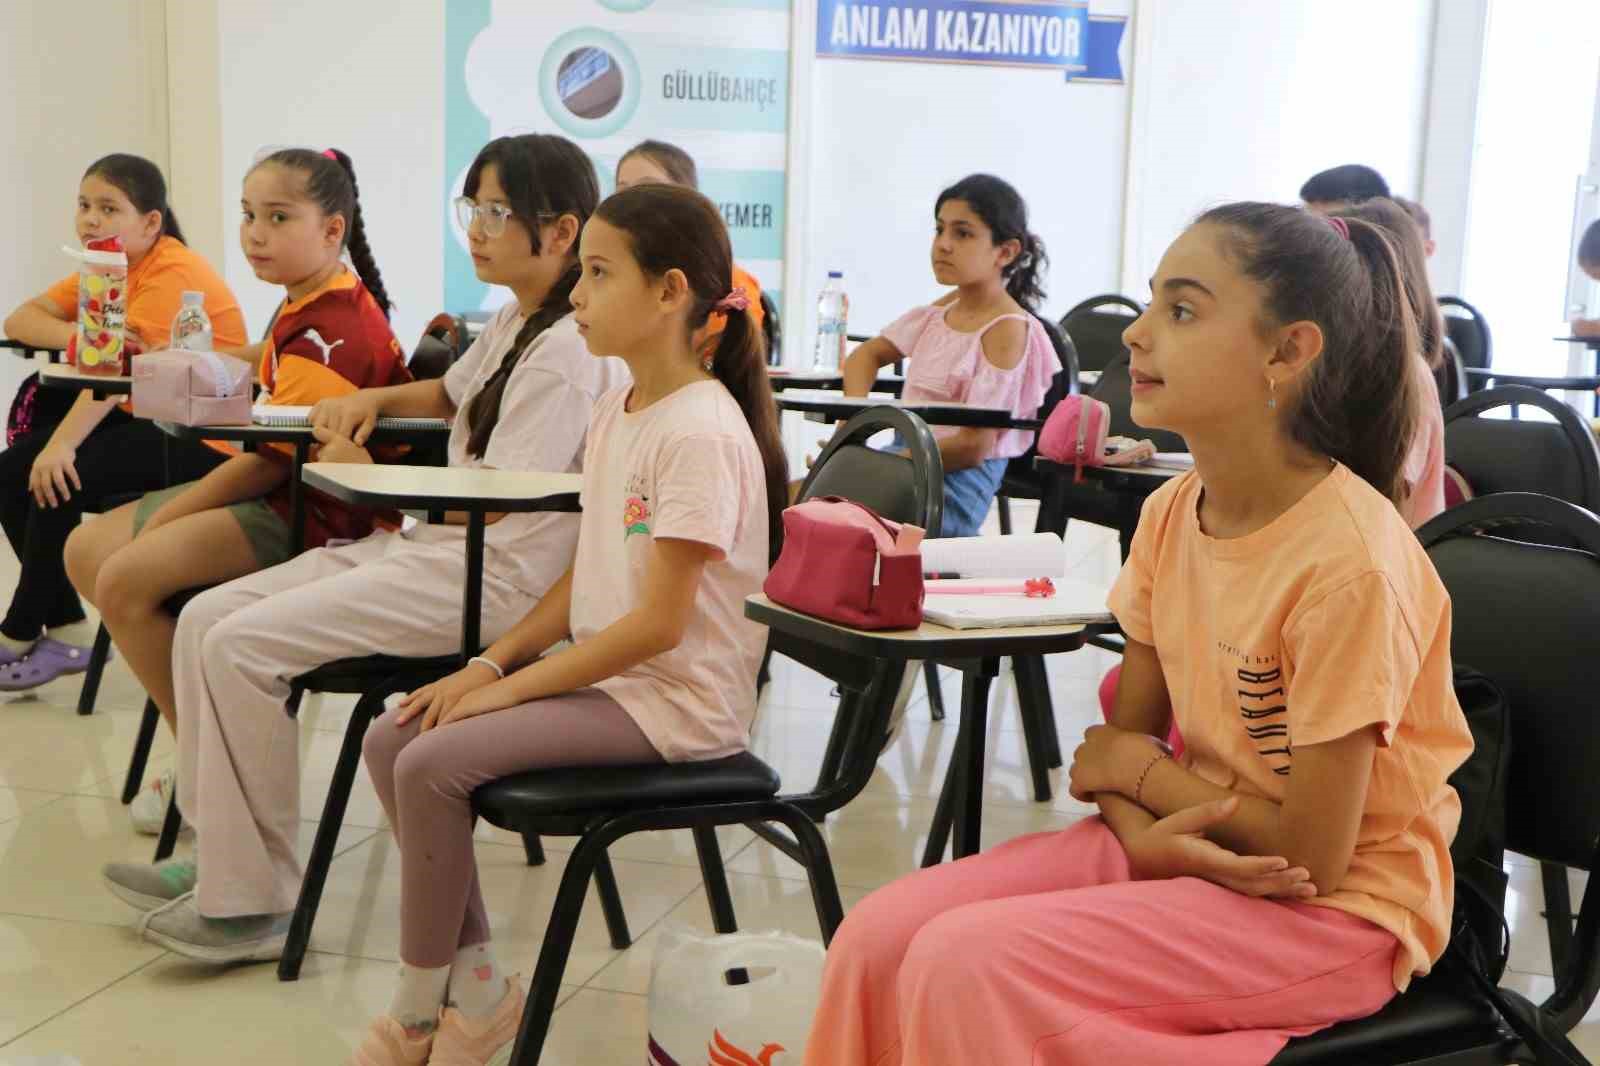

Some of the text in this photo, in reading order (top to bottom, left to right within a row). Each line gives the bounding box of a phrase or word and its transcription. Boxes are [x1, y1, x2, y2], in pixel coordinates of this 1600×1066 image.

[830, 4, 1081, 57] ANLAM KAZANIYOR
[663, 69, 777, 112] GÜLLÜBAHÇE
[720, 203, 772, 227] EMER
